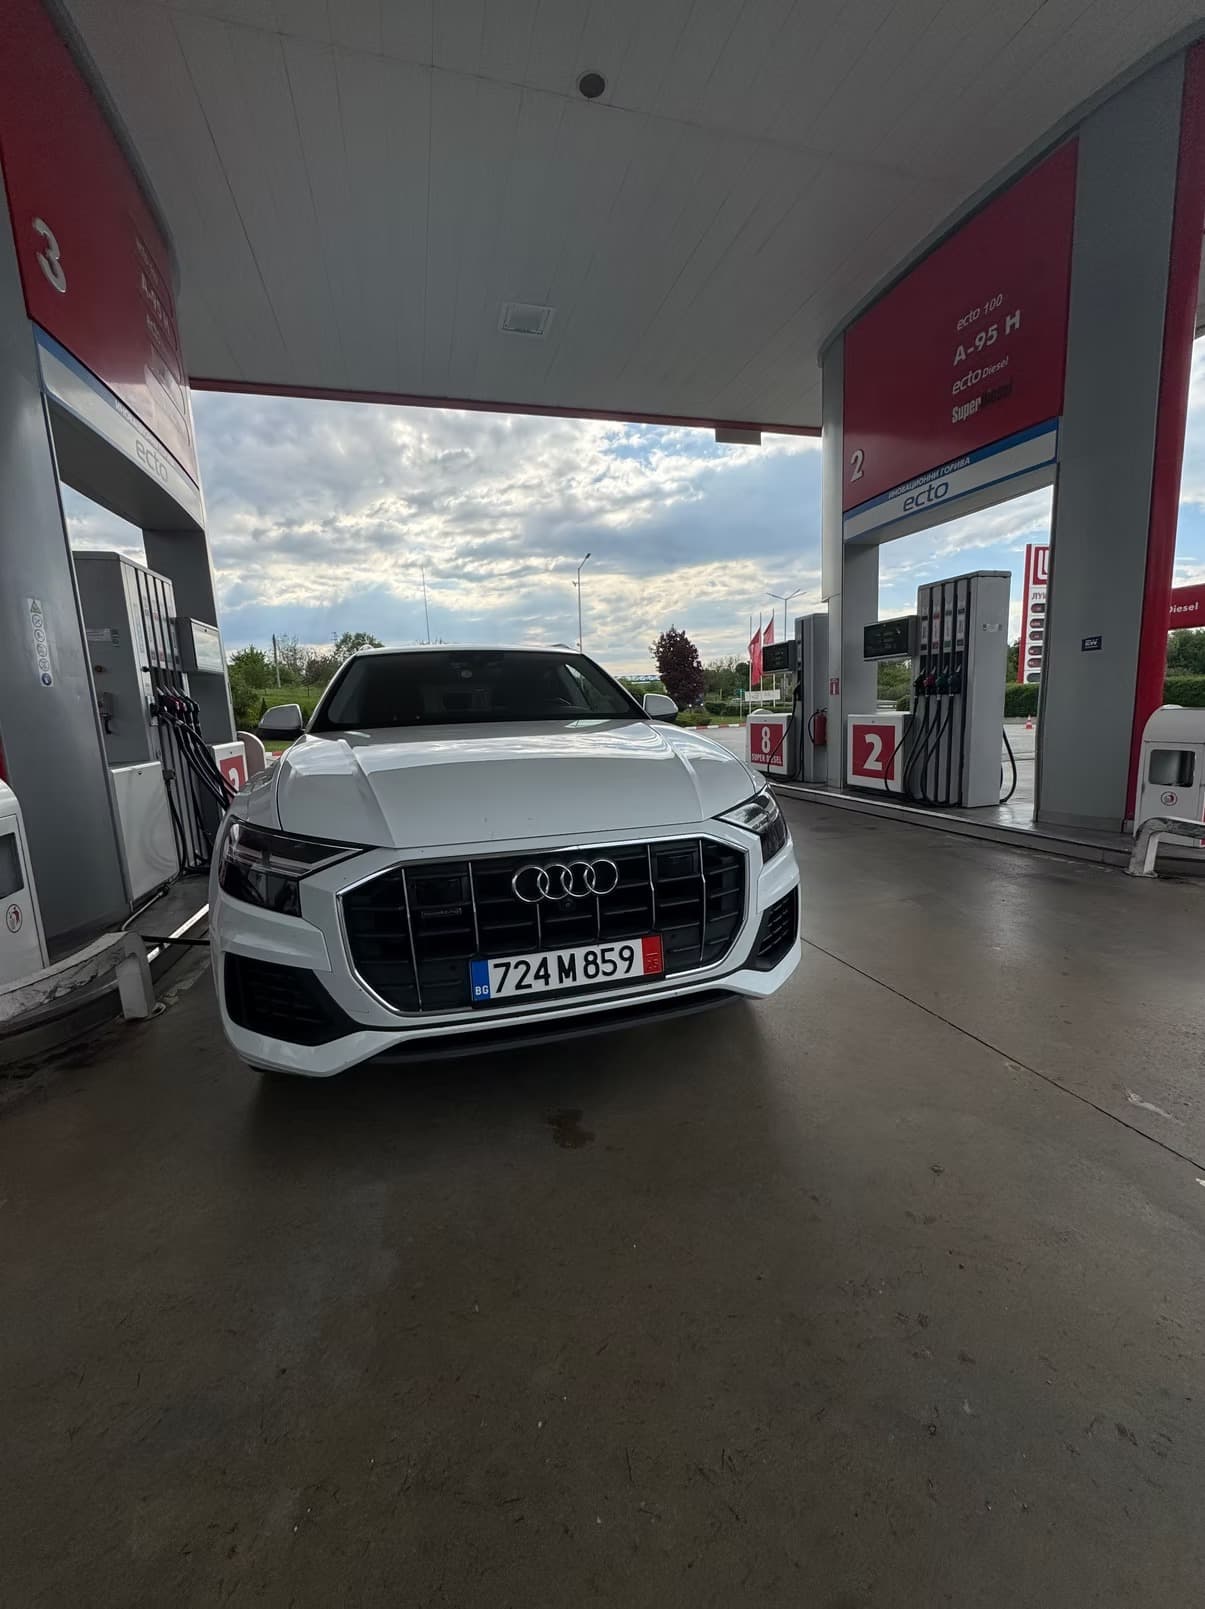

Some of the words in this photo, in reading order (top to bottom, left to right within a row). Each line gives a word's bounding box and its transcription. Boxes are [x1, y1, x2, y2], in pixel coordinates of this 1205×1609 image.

[32, 217, 67, 293] 3
[957, 308, 981, 330] ecto
[984, 293, 1003, 315] 100
[953, 324, 999, 367] A-95
[1006, 309, 1022, 336] H
[135, 439, 169, 484] ecto
[850, 449, 865, 482] 2
[903, 481, 949, 512] ecto
[761, 726, 771, 754] 8
[864, 734, 882, 770] 2
[751, 753, 765, 762] SUPER
[766, 754, 782, 764] DESEL
[475, 986, 489, 995] BG
